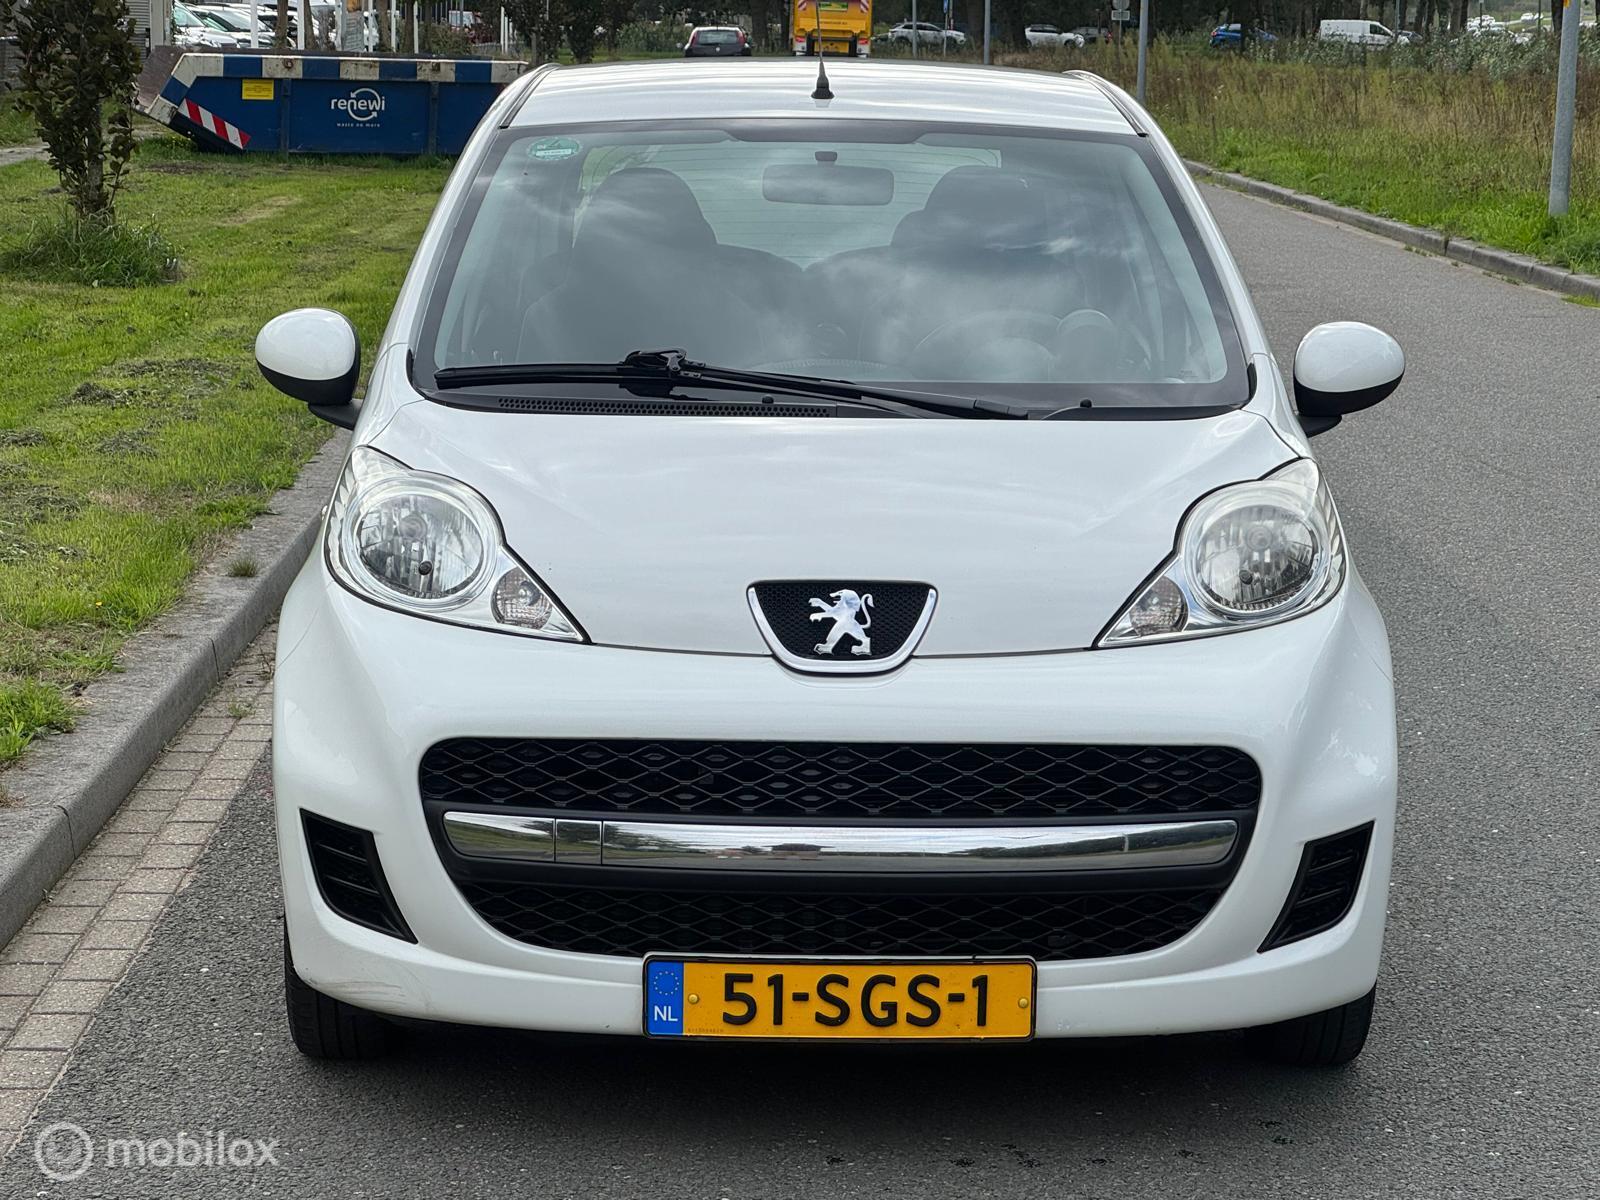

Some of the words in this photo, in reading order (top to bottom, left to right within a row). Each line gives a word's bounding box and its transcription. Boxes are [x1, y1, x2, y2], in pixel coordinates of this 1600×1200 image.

[331, 96, 385, 111] renewi
[653, 1005, 679, 1022] NL
[722, 972, 989, 1028] 51-SGS-1
